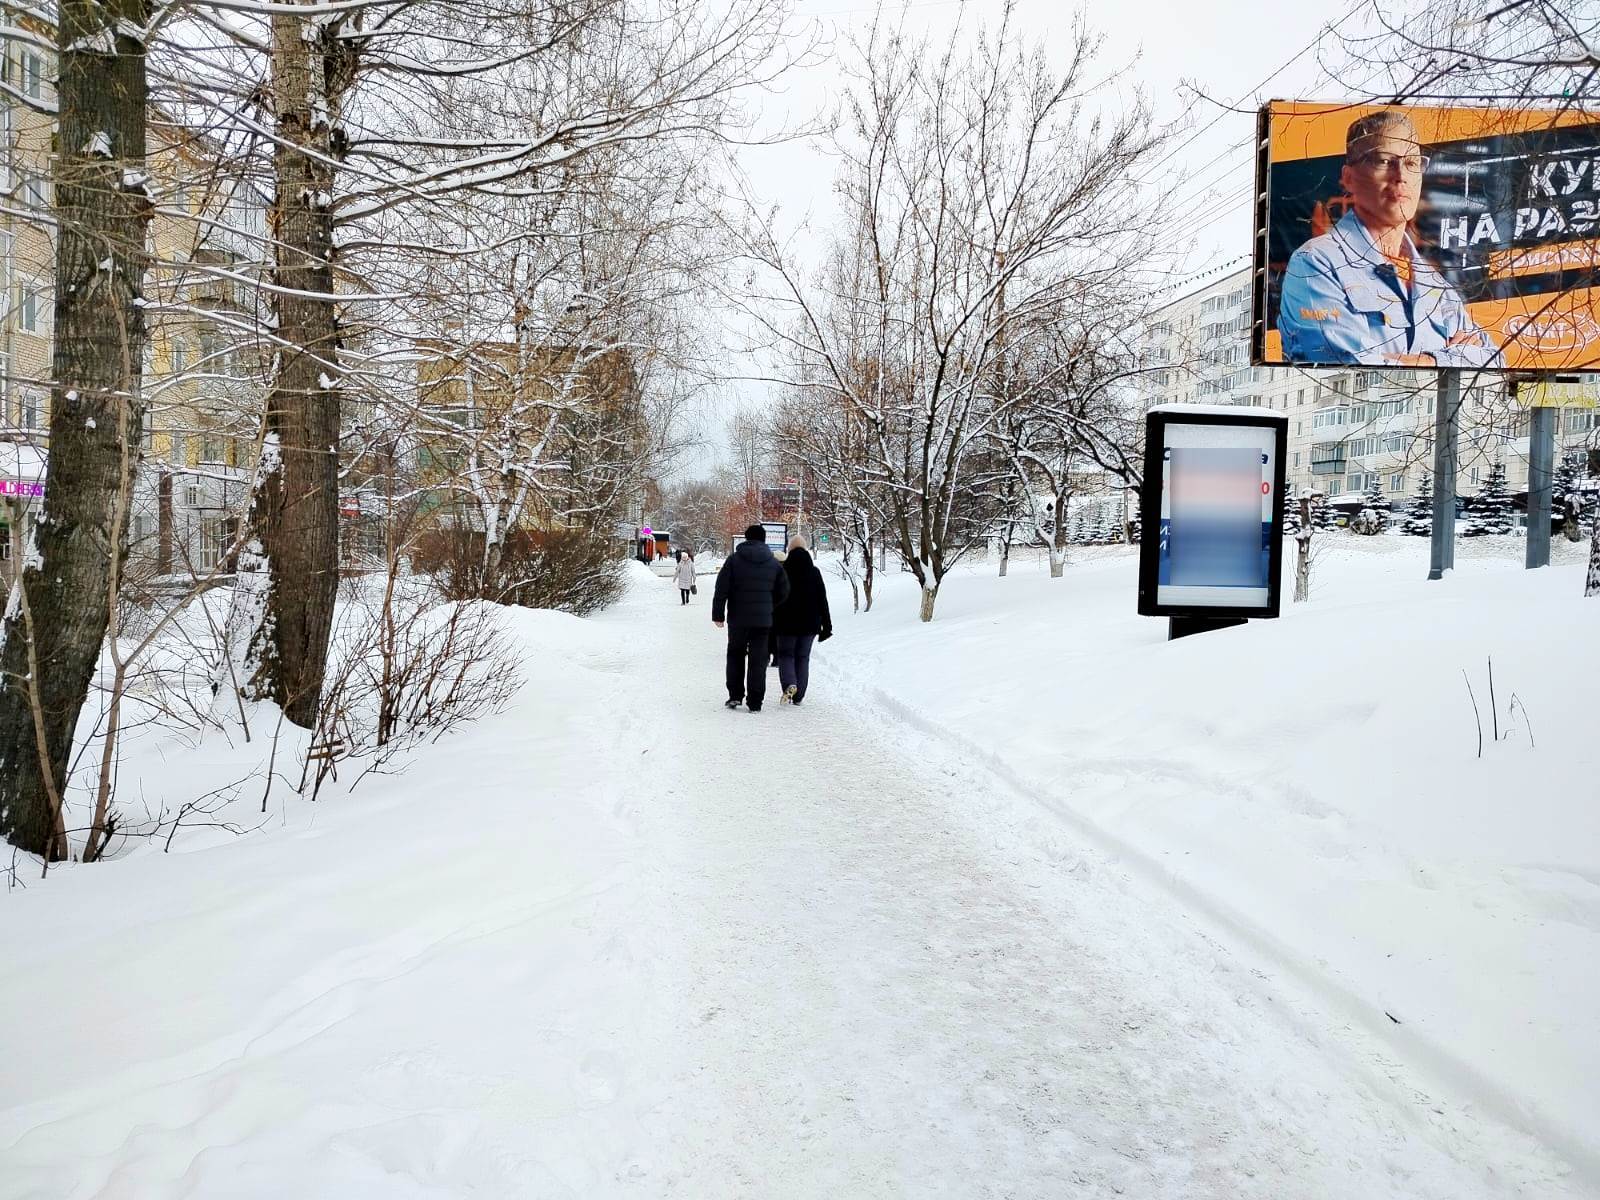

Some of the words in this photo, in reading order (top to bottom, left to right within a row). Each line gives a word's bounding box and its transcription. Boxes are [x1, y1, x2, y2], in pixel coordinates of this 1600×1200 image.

[1527, 156, 1600, 199] КУ
[1440, 212, 1501, 250] НА
[1513, 198, 1600, 241] РАЗ
